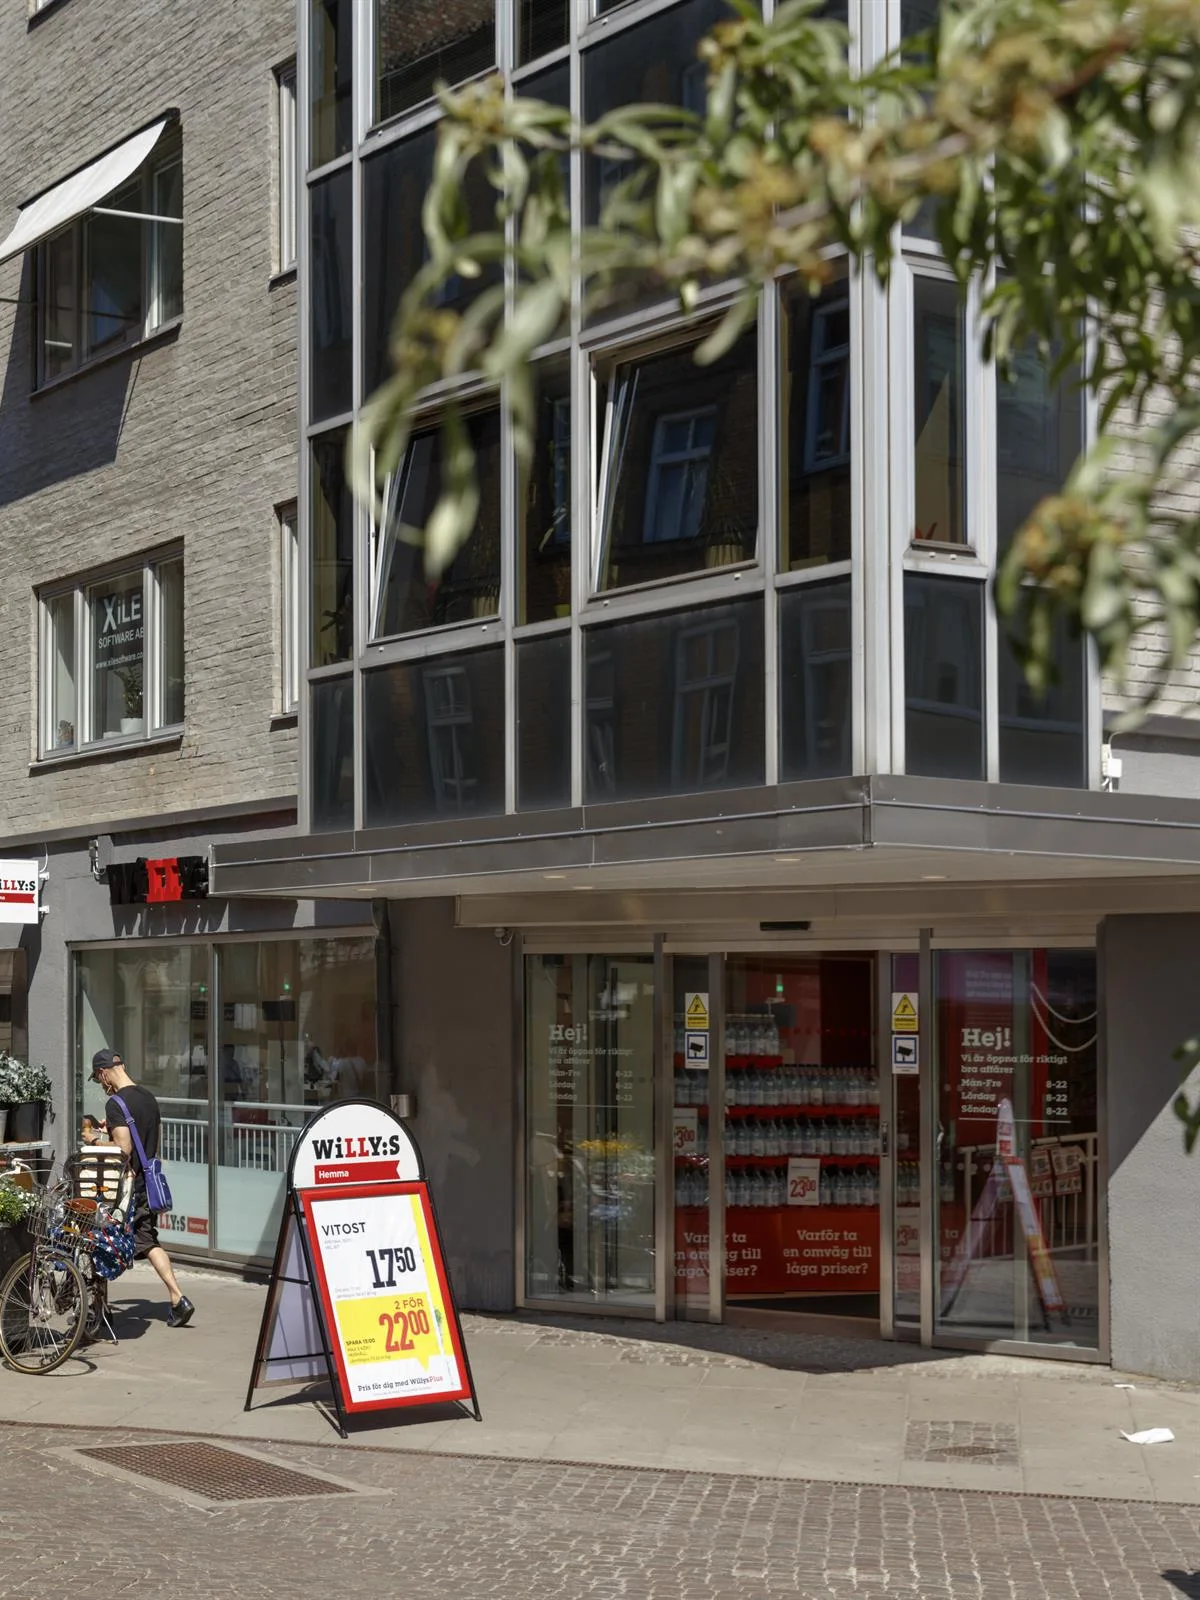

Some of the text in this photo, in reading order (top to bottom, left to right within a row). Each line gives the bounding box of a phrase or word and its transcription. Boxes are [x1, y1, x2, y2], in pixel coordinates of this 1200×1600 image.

[98, 631, 135, 649] SOFTWARE
[96, 651, 144, 670] www.xilesoftware.co
[548, 1024, 587, 1044] Hej!
[961, 1027, 1012, 1050] Hej!
[961, 1054, 1068, 1065] Vi är öppna för riktigt
[961, 1065, 1014, 1074] bra affärer
[1046, 1081, 1068, 1089] 8-22
[961, 1092, 1068, 1102] Lördag 8-22
[961, 1105, 1068, 1115] Söndag 8-22
[318, 1170, 349, 1179] Hemma
[322, 1222, 366, 1236] VITOST
[732, 1233, 747, 1243] ta
[797, 1230, 858, 1241] Varför ta
[742, 1248, 761, 1259] till
[783, 1247, 872, 1259] en omväg till
[786, 1263, 869, 1277] låga priser?
[394, 1297, 424, 1310] 2 FÖR
[395, 1380, 409, 1388] med
[409, 1376, 443, 1386] WillysPlus
